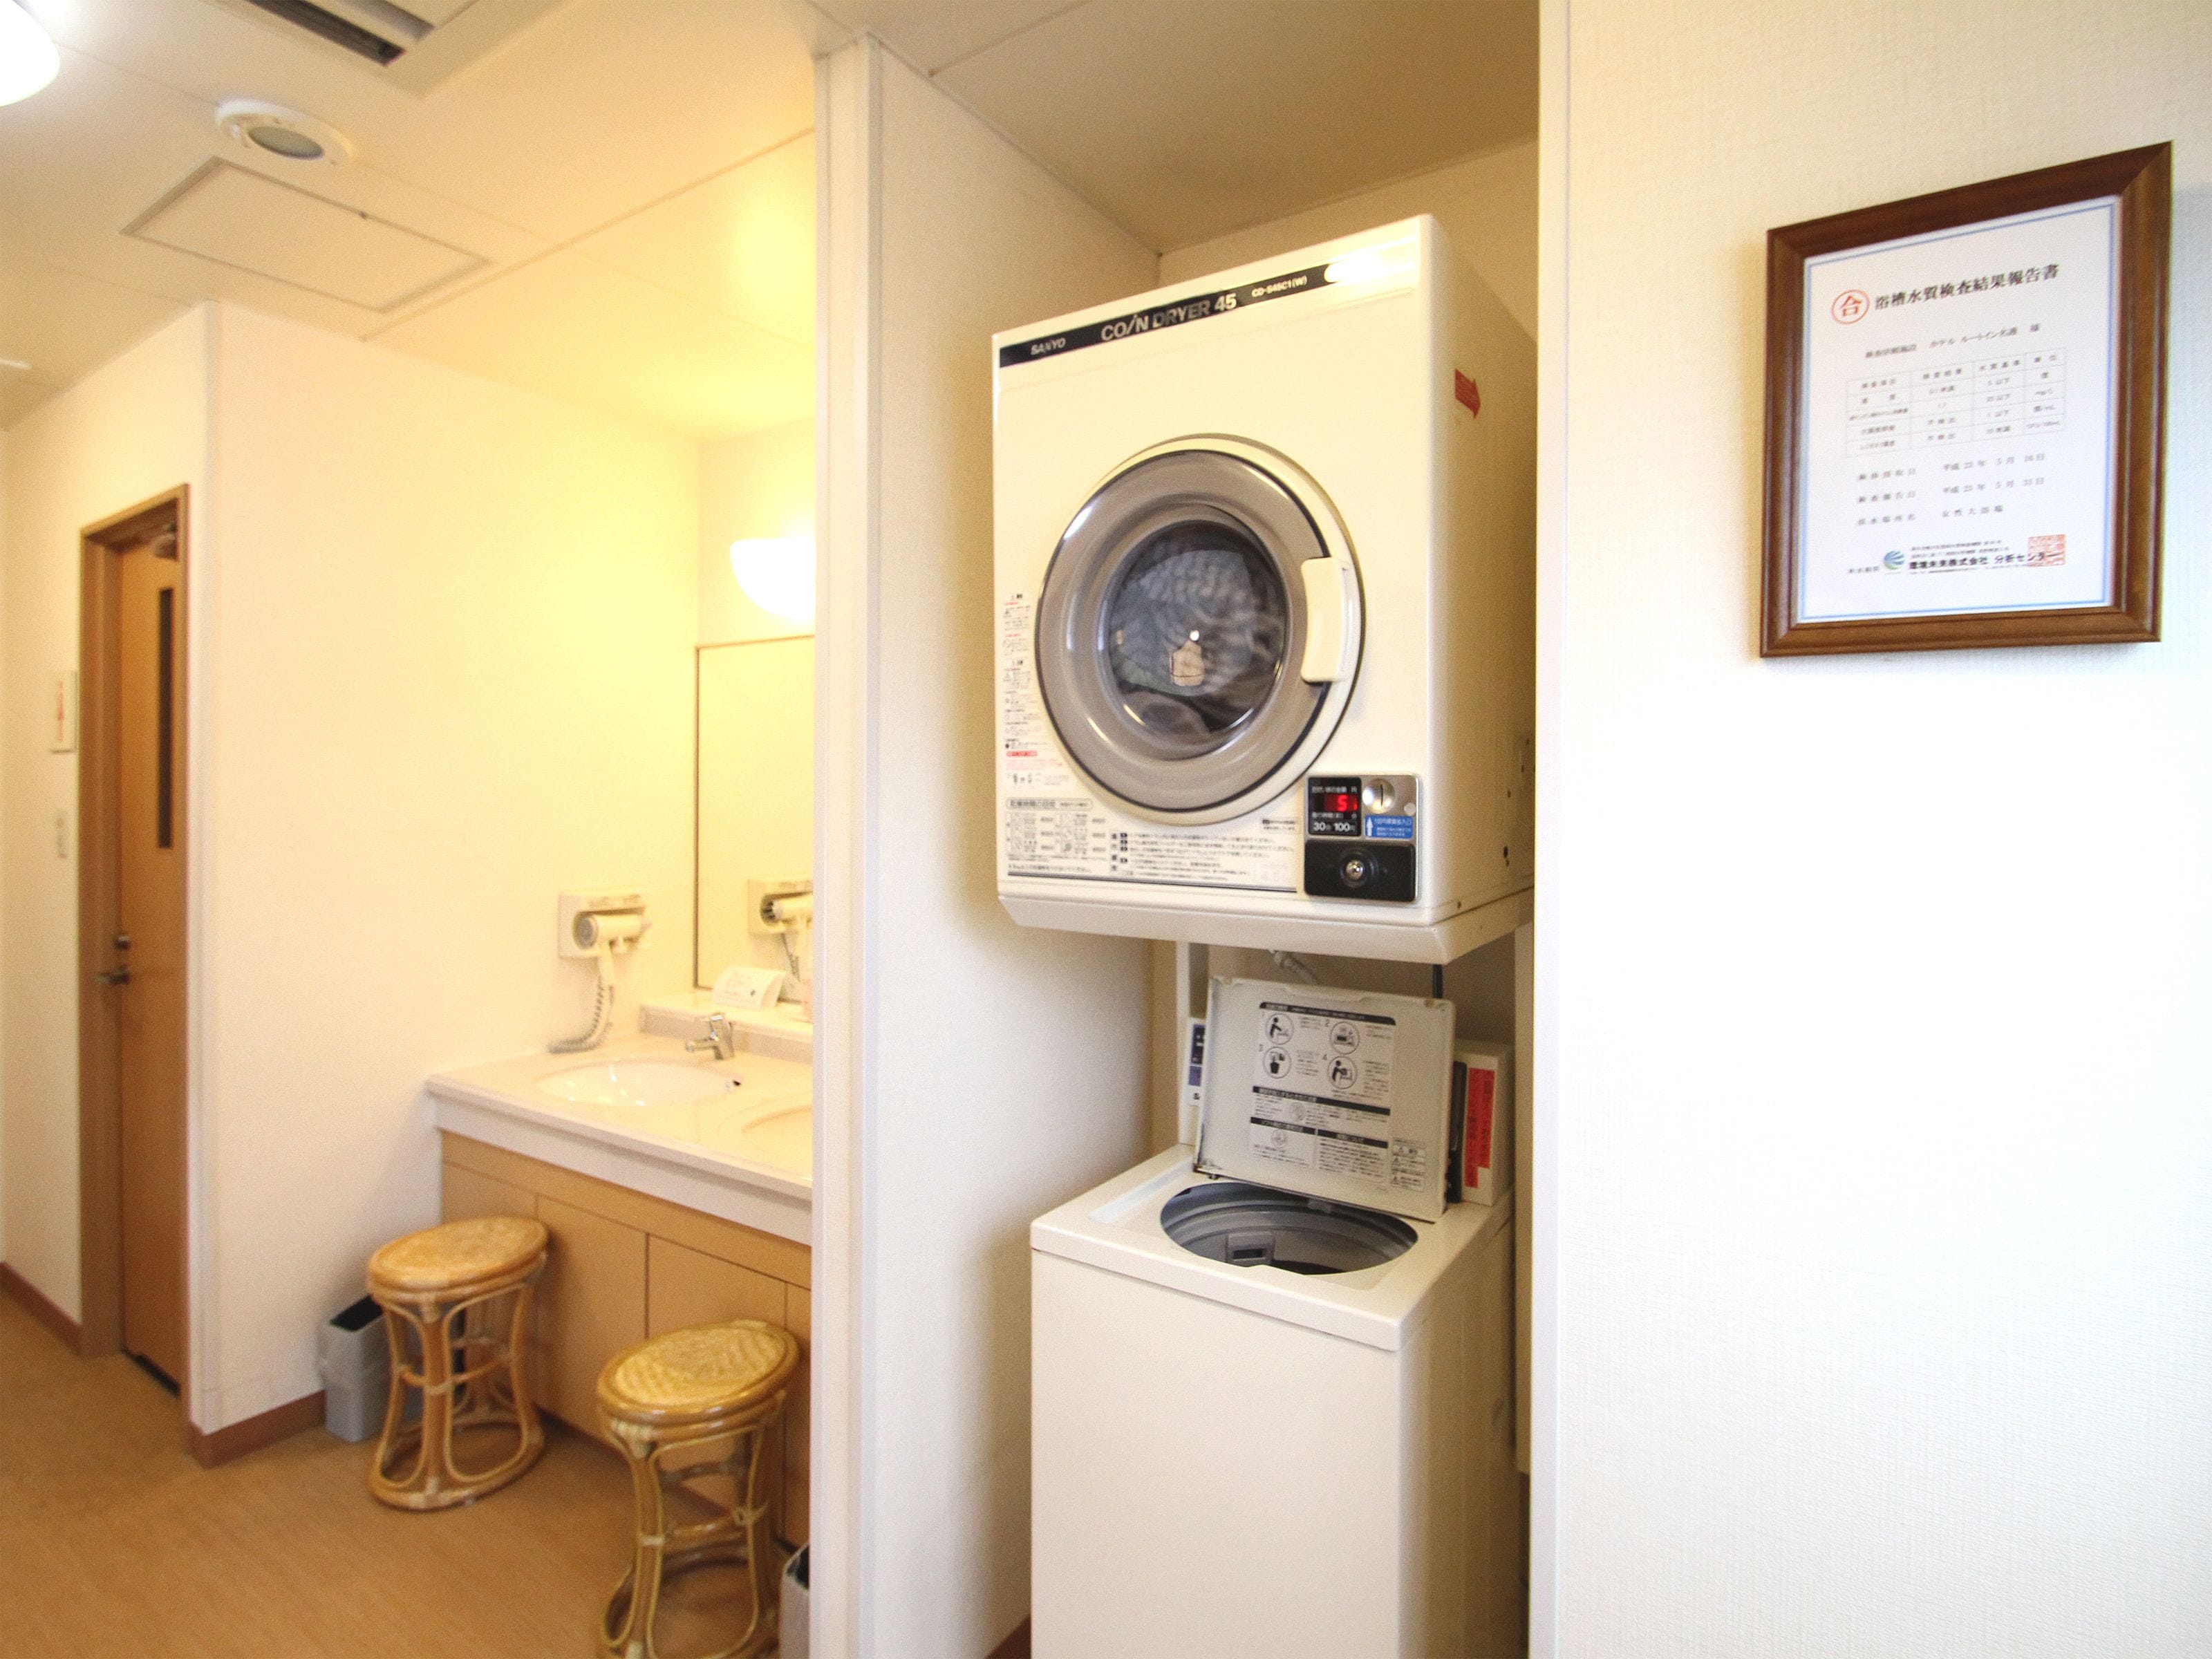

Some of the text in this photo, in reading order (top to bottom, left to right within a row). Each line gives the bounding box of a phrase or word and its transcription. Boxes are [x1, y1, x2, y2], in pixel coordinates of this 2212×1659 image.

[1874, 263, 2059, 310] 浴槽水質検査結果報告書
[1030, 337, 1067, 355] SANYO
[1152, 300, 1210, 328] DRYER
[1214, 293, 1237, 311] 45
